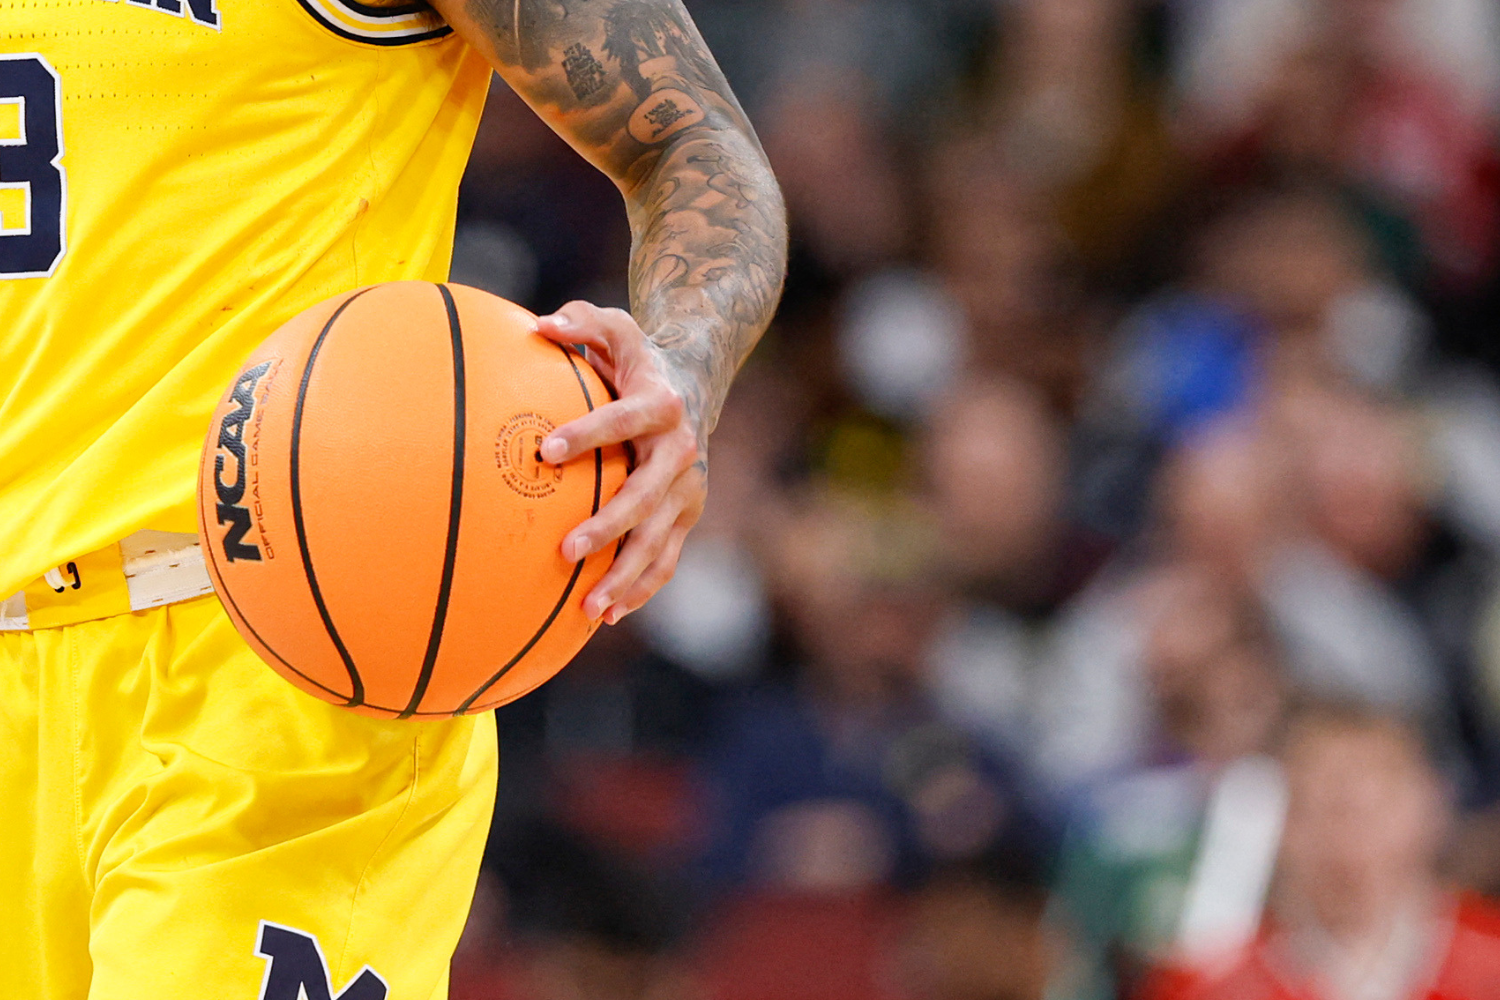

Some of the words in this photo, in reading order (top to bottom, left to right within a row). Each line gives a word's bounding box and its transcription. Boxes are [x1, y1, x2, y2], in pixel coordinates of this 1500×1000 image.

[214, 361, 272, 563] NCAA
[251, 411, 265, 467] GAME
[251, 474, 275, 560] OFFICIAL
